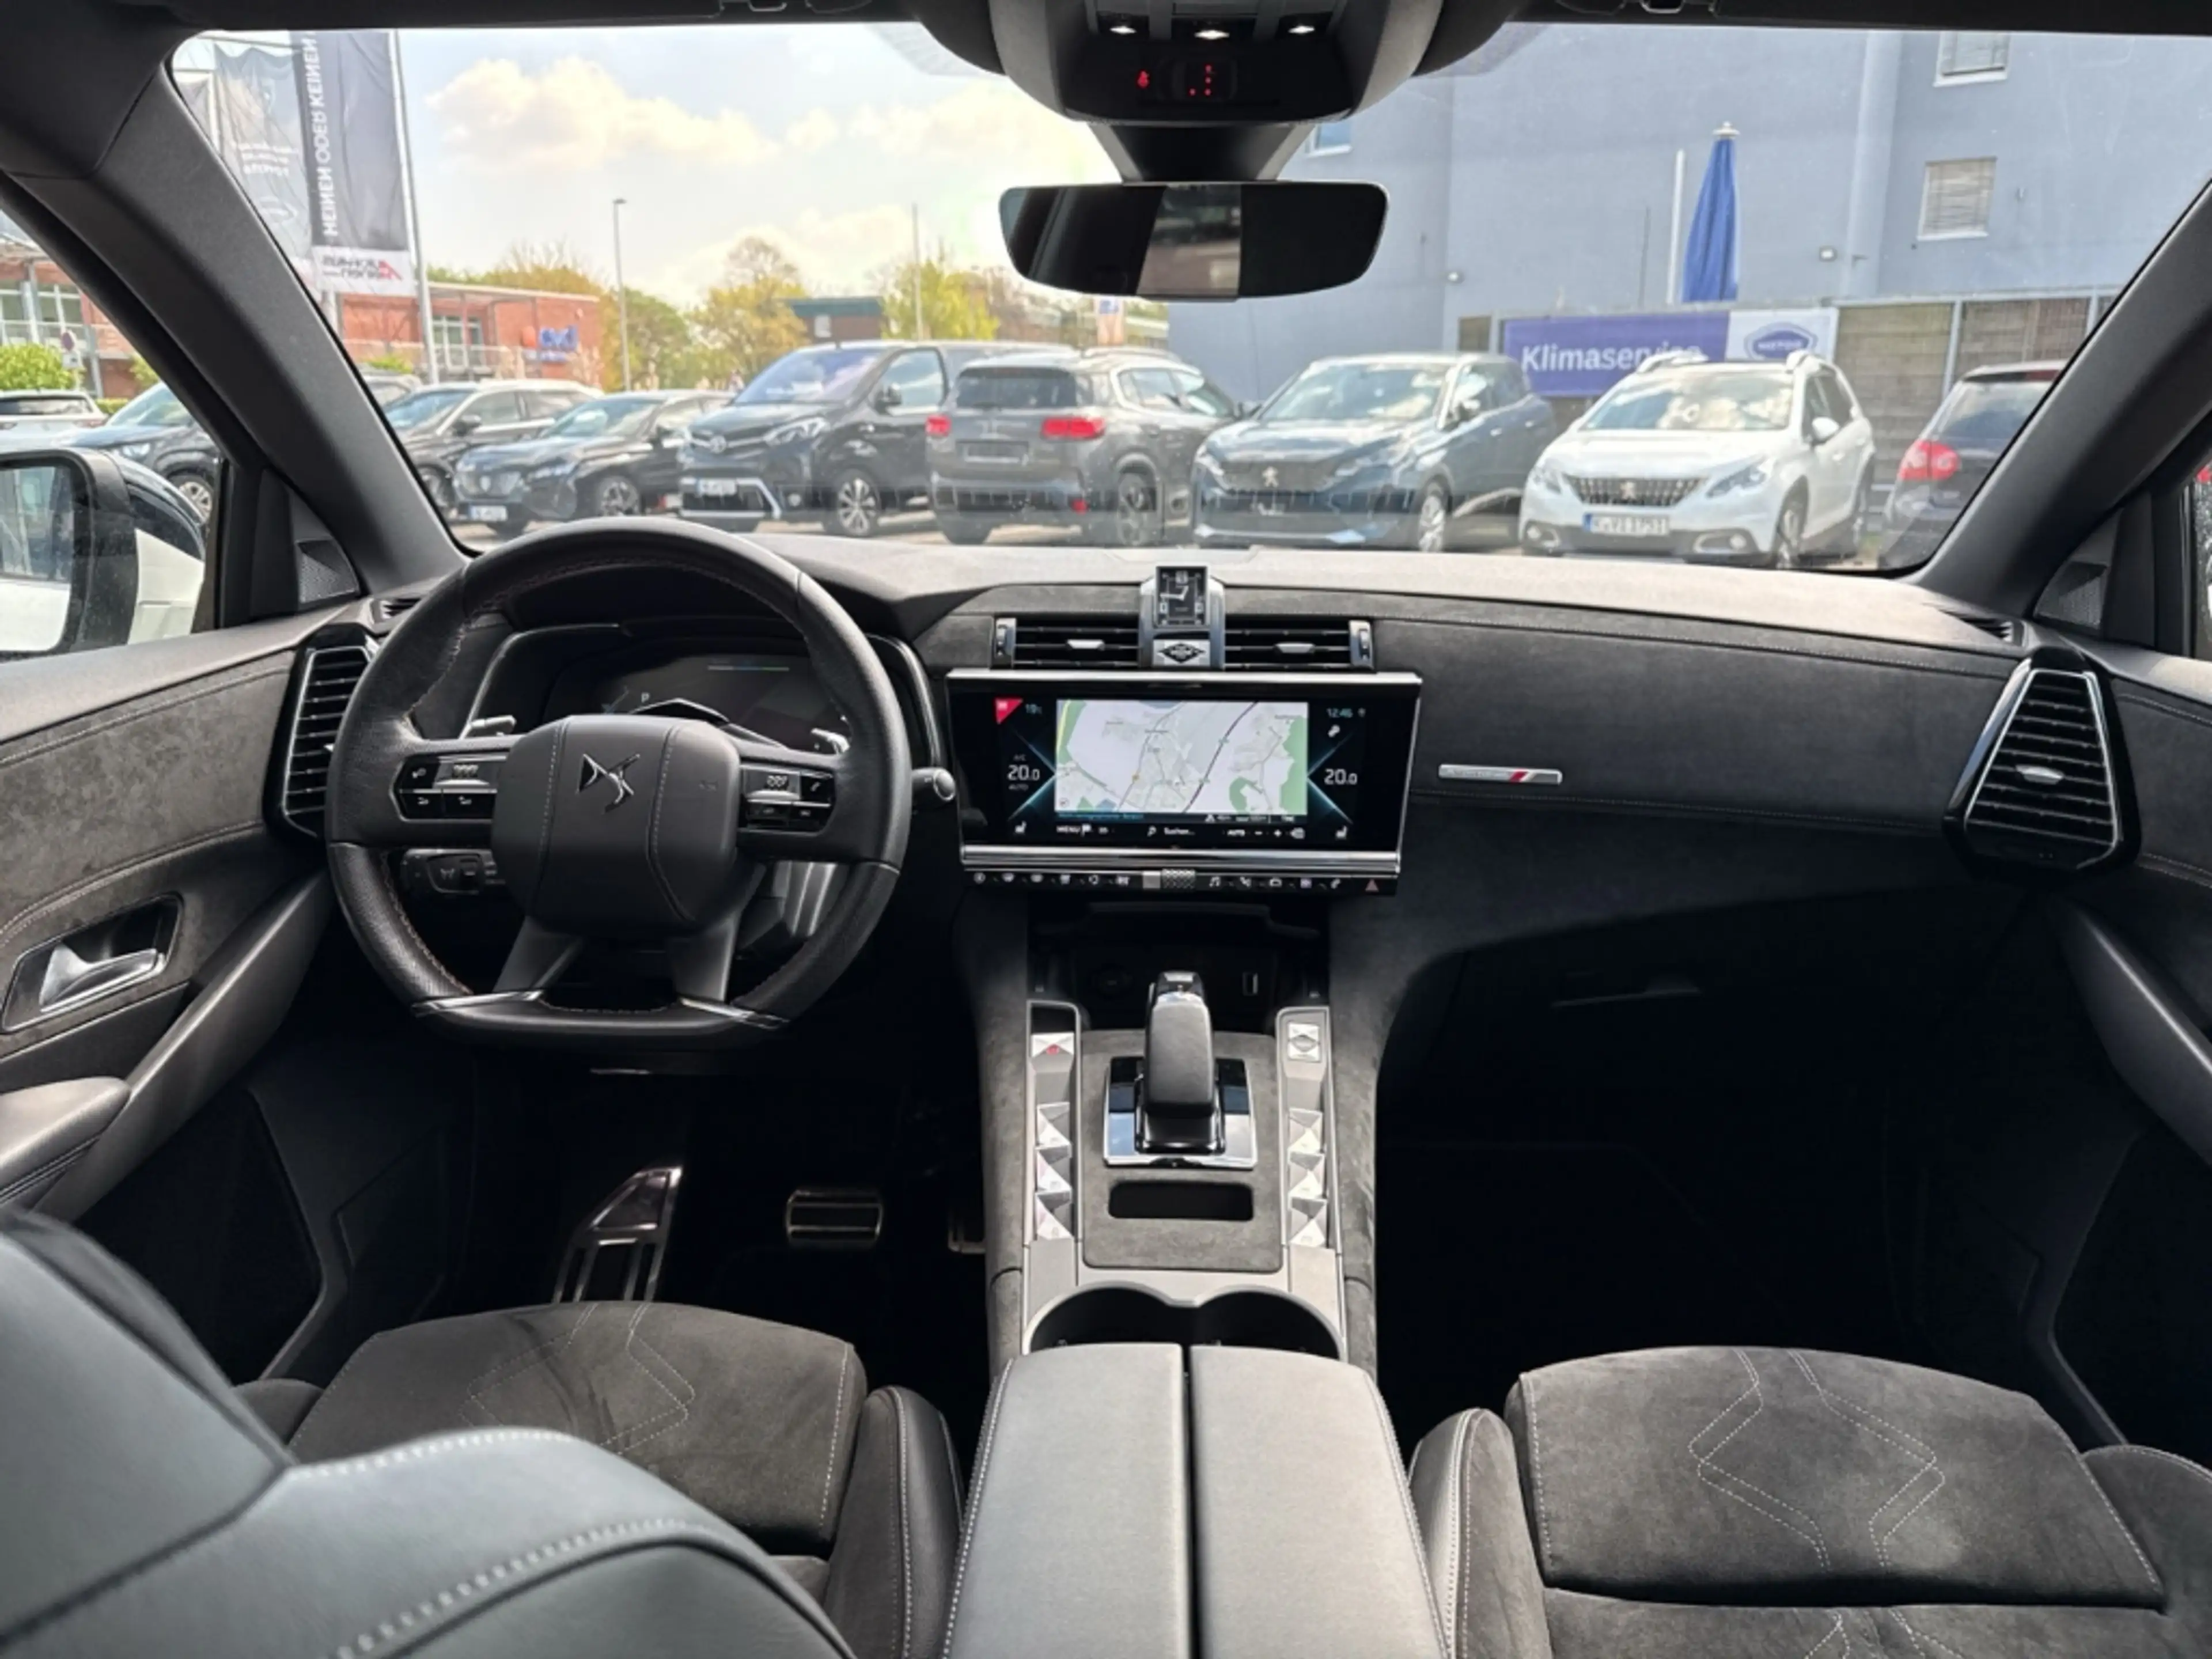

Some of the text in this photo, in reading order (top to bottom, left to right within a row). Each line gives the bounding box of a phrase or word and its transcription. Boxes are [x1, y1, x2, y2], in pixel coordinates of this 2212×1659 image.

[1522, 340, 1702, 372] Klimaser
[641, 692, 650, 703] P
[1007, 764, 1040, 781] 20.0
[1324, 768, 1358, 785] 20.0
